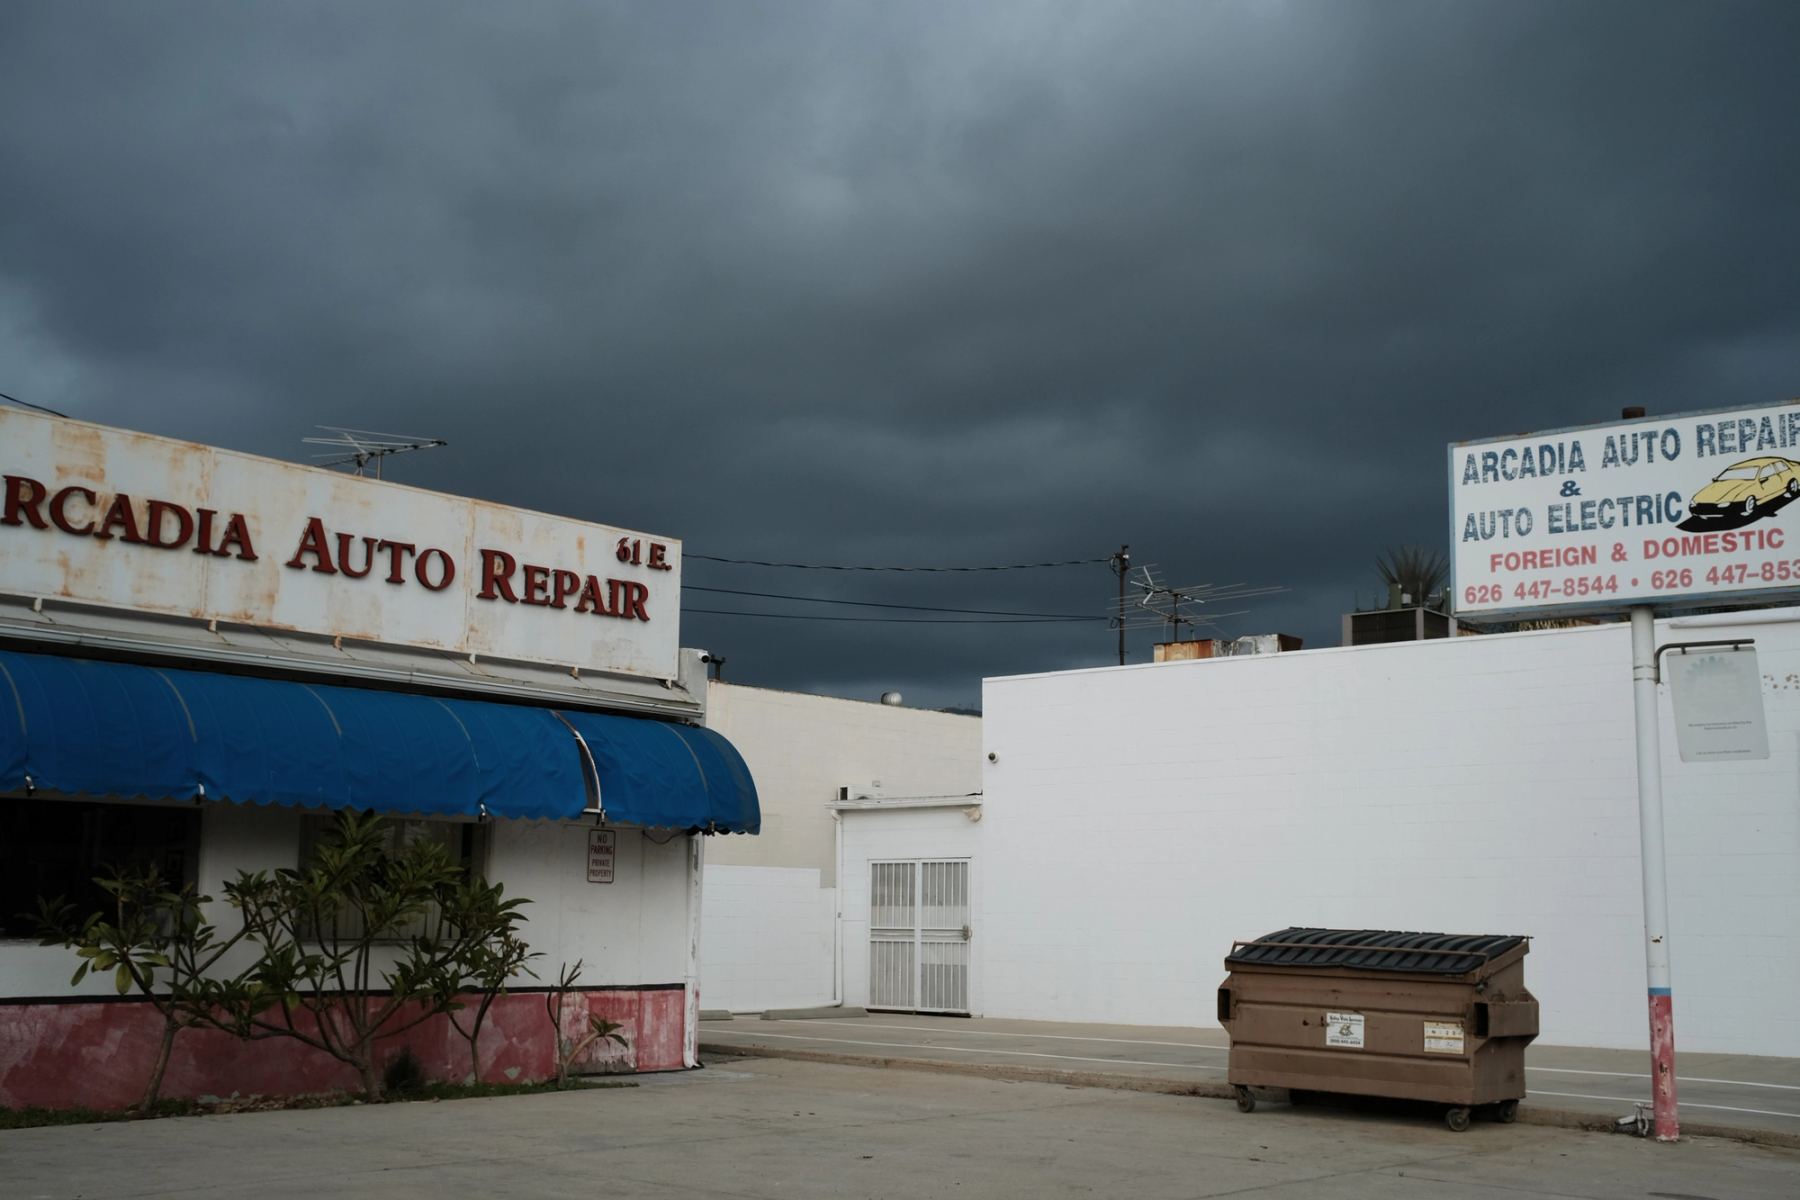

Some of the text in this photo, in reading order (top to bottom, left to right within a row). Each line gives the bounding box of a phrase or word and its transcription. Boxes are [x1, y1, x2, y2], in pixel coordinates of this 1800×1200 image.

[1462, 440, 1587, 486] ARCADIA
[1601, 427, 1682, 469] AUTO
[1559, 480, 1582, 497] &
[1462, 491, 1683, 543] AUTO ELECTRIC
[616, 537, 672, 571] 61 E.
[1490, 527, 1785, 573] FOREIGN & DOMESTIC
[285, 516, 456, 592] AUTO
[477, 548, 651, 623] REPAIR
[1464, 584, 1503, 604] 626
[1514, 575, 1618, 600] 447-8544
[1651, 568, 1693, 590] 626
[591, 845, 613, 855] PARKING
[597, 834, 608, 844] NO
